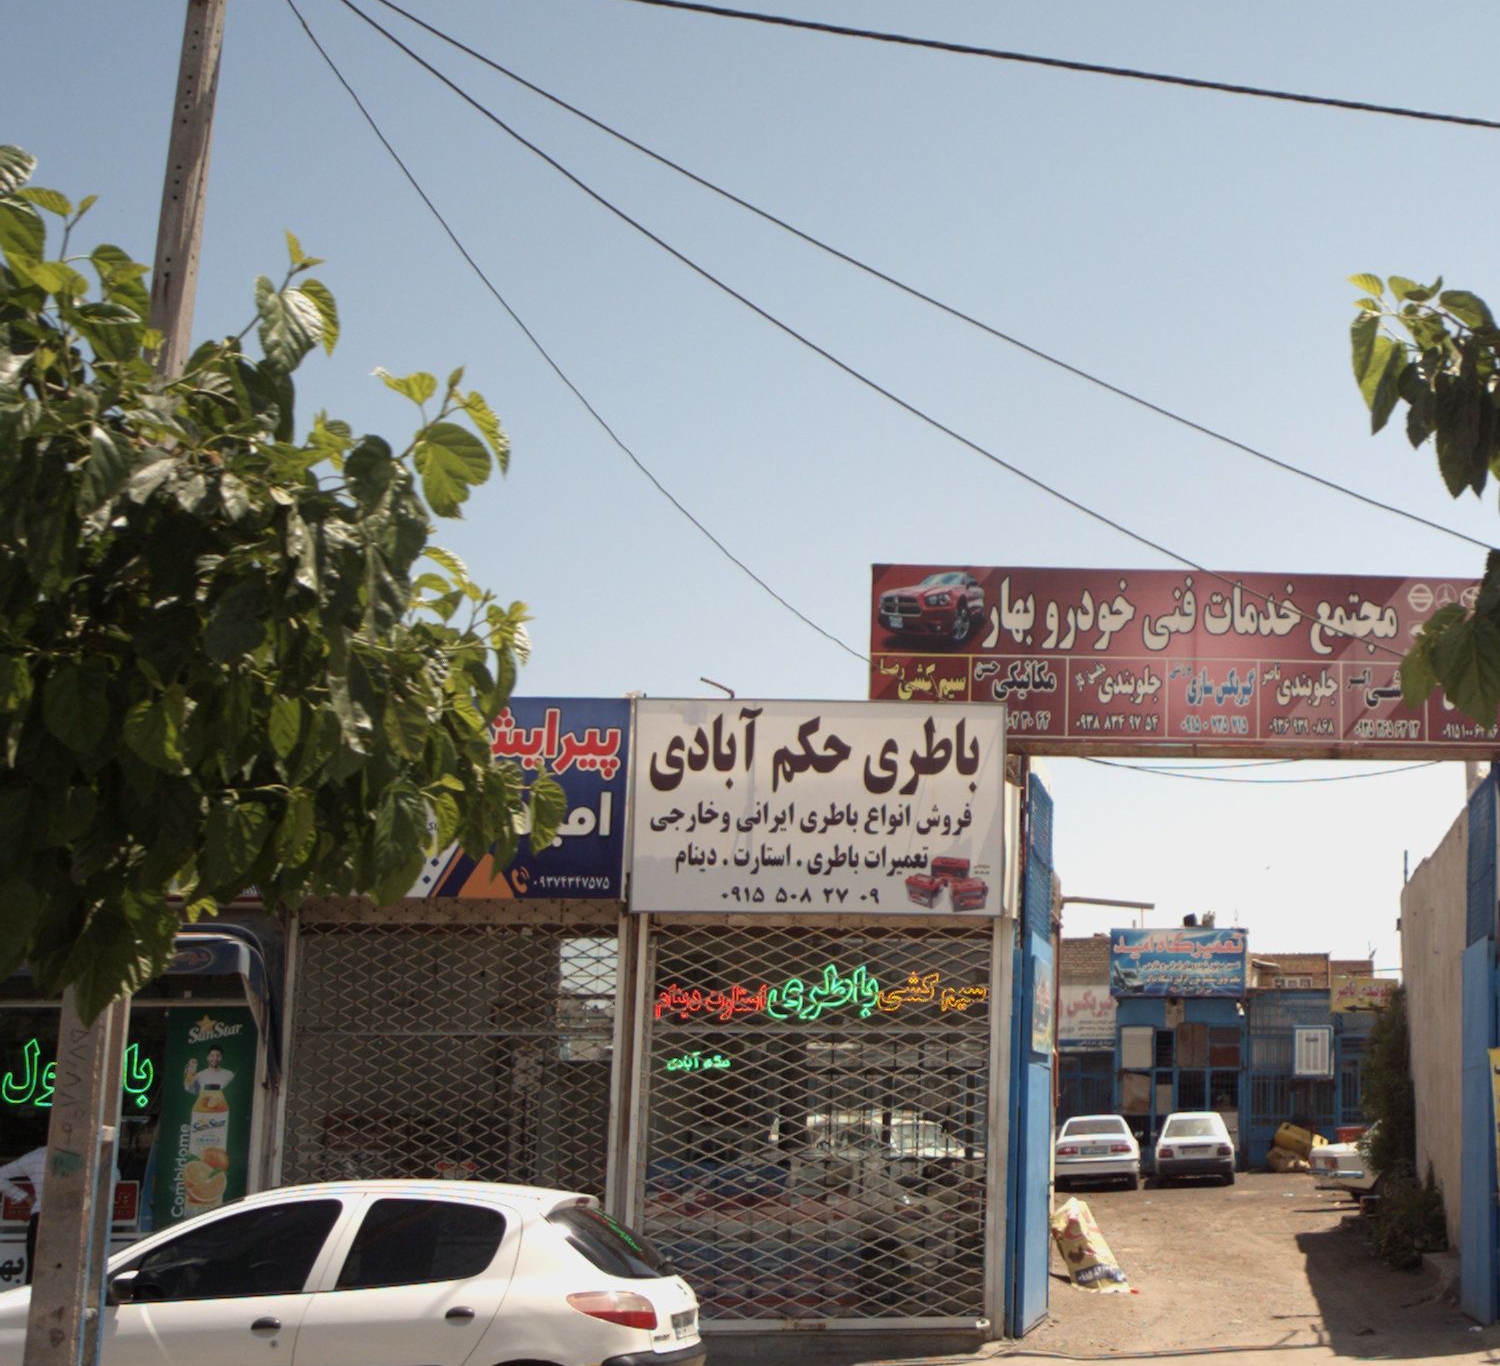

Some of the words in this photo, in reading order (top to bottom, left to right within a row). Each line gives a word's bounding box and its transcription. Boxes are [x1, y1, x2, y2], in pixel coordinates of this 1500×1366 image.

[981, 575, 1035, 649] بهار
[1042, 578, 1136, 650] خودرو
[1143, 574, 1197, 651] فنی
[1204, 579, 1302, 636] خدمات
[1311, 593, 1398, 654] مجتمع
[993, 660, 1057, 700] مکانیکی
[1097, 666, 1162, 704] جلوبندی
[1215, 666, 1257, 707] گیربکس
[1277, 670, 1339, 707] جلوبندی
[649, 707, 764, 793] آبادی
[772, 715, 853, 793] حکم
[864, 715, 980, 795] باطری
[736, 801, 795, 835] ایرانی
[799, 801, 859, 834] باطری
[864, 803, 911, 835] انواع
[916, 803, 973, 836] فروش
[675, 843, 718, 875] دینام
[733, 843, 792, 876] استارت
[806, 843, 860, 876] باطری
[864, 843, 929, 877] تعمیرات
[721, 885, 766, 904] ۰۹۱۵
[775, 885, 812, 904] ۵۰۸
[860, 887, 881, 905] ۰۹
[766, 963, 880, 1020] باطری
[170, 1123, 191, 1219] Combidome
